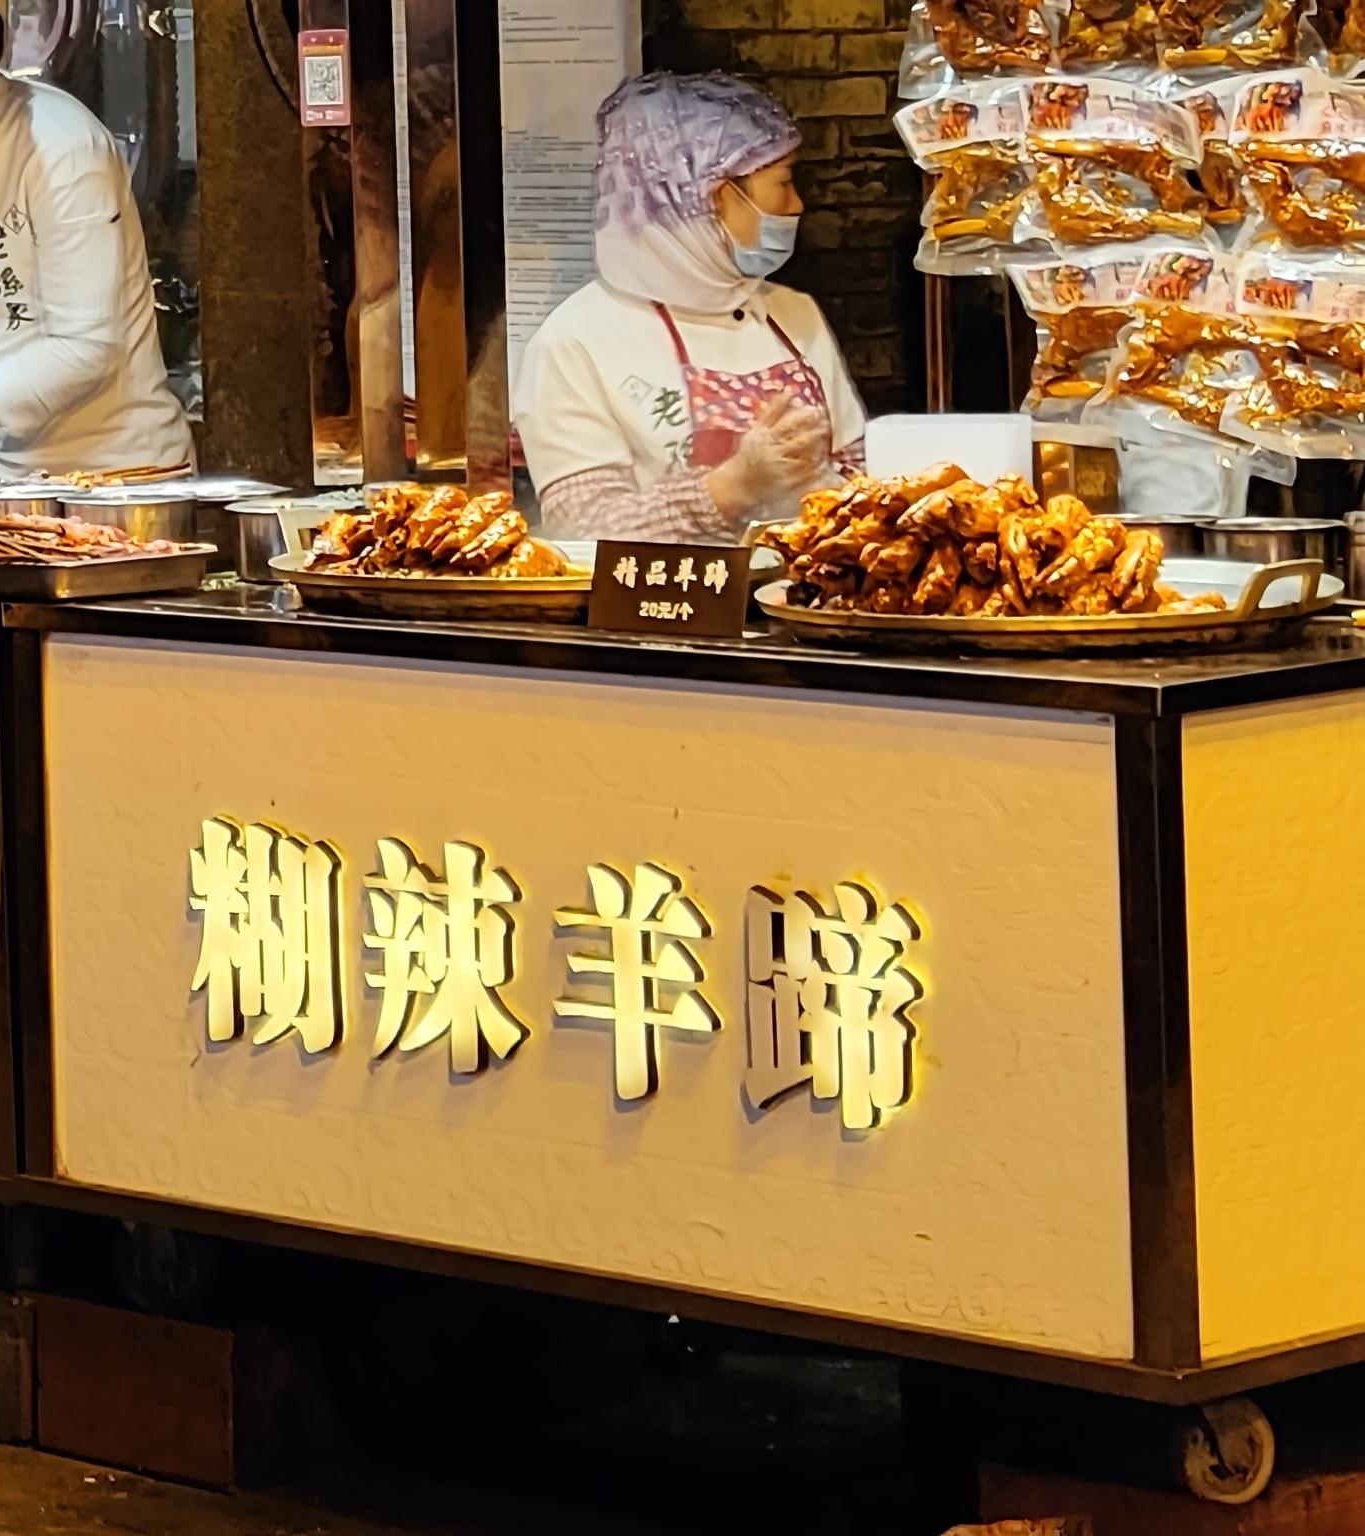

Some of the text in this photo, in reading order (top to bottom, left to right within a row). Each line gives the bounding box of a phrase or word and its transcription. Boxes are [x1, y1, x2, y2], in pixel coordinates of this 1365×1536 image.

[639, 601, 694, 621] 20元/个
[189, 814, 924, 1130] 糊辣羊蹄
